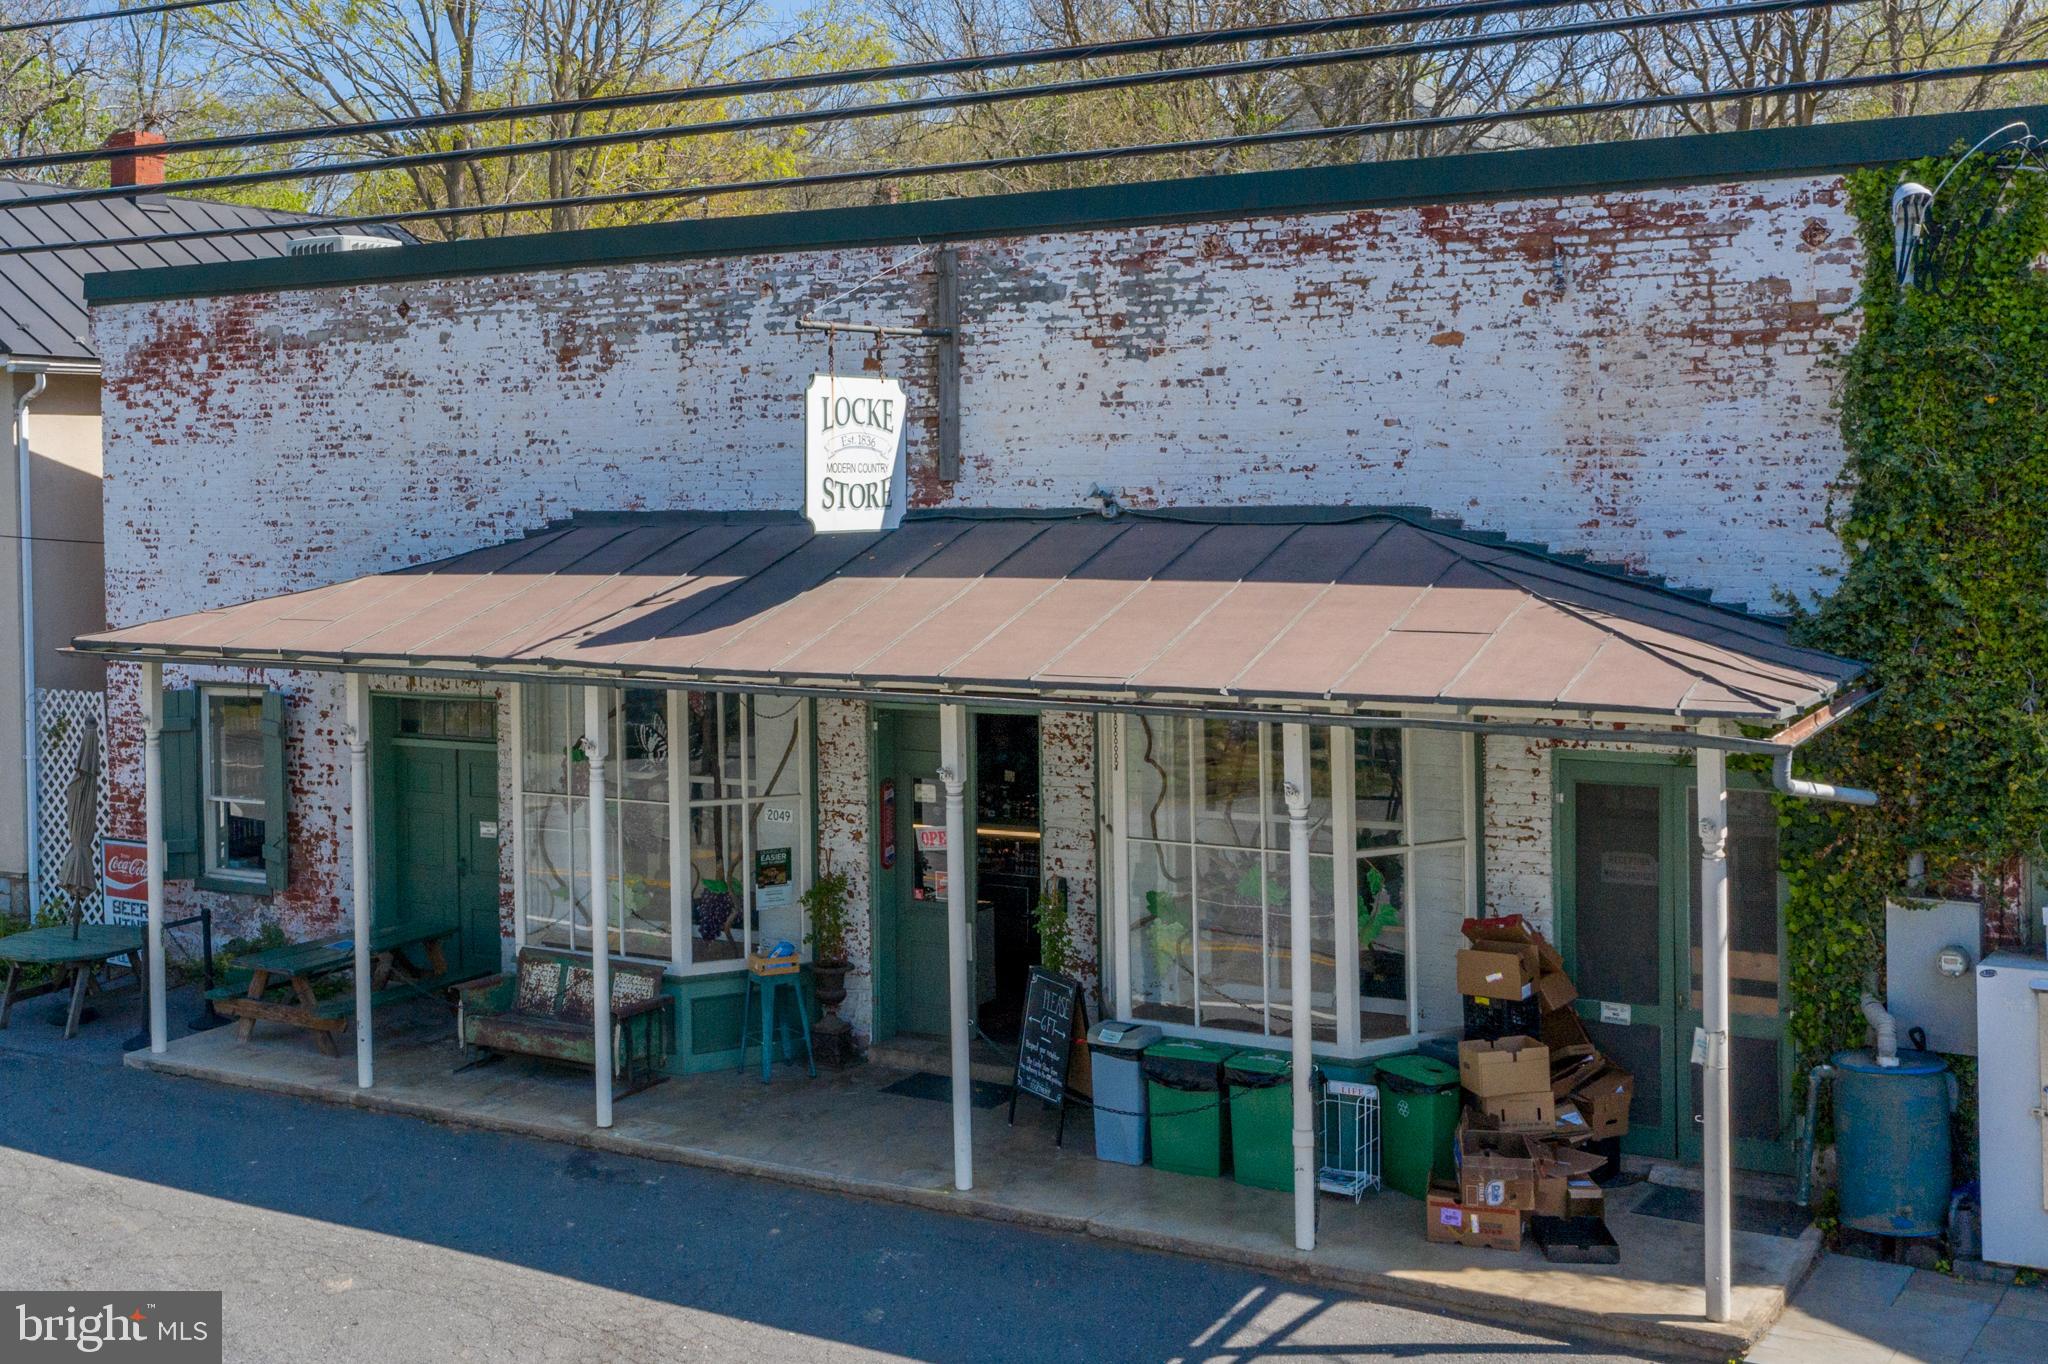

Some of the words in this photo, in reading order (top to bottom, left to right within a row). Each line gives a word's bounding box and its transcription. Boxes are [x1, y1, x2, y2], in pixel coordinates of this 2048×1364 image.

[821, 396, 894, 434] LOCKE
[858, 434, 876, 448] 1836
[826, 463, 857, 474] MODERN
[857, 463, 889, 474] COUNTRY
[821, 476, 893, 510] STORE
[767, 809, 791, 821] 2049
[921, 831, 948, 848] OPE
[760, 853, 787, 862] EASIER
[113, 900, 148, 918] BEER
